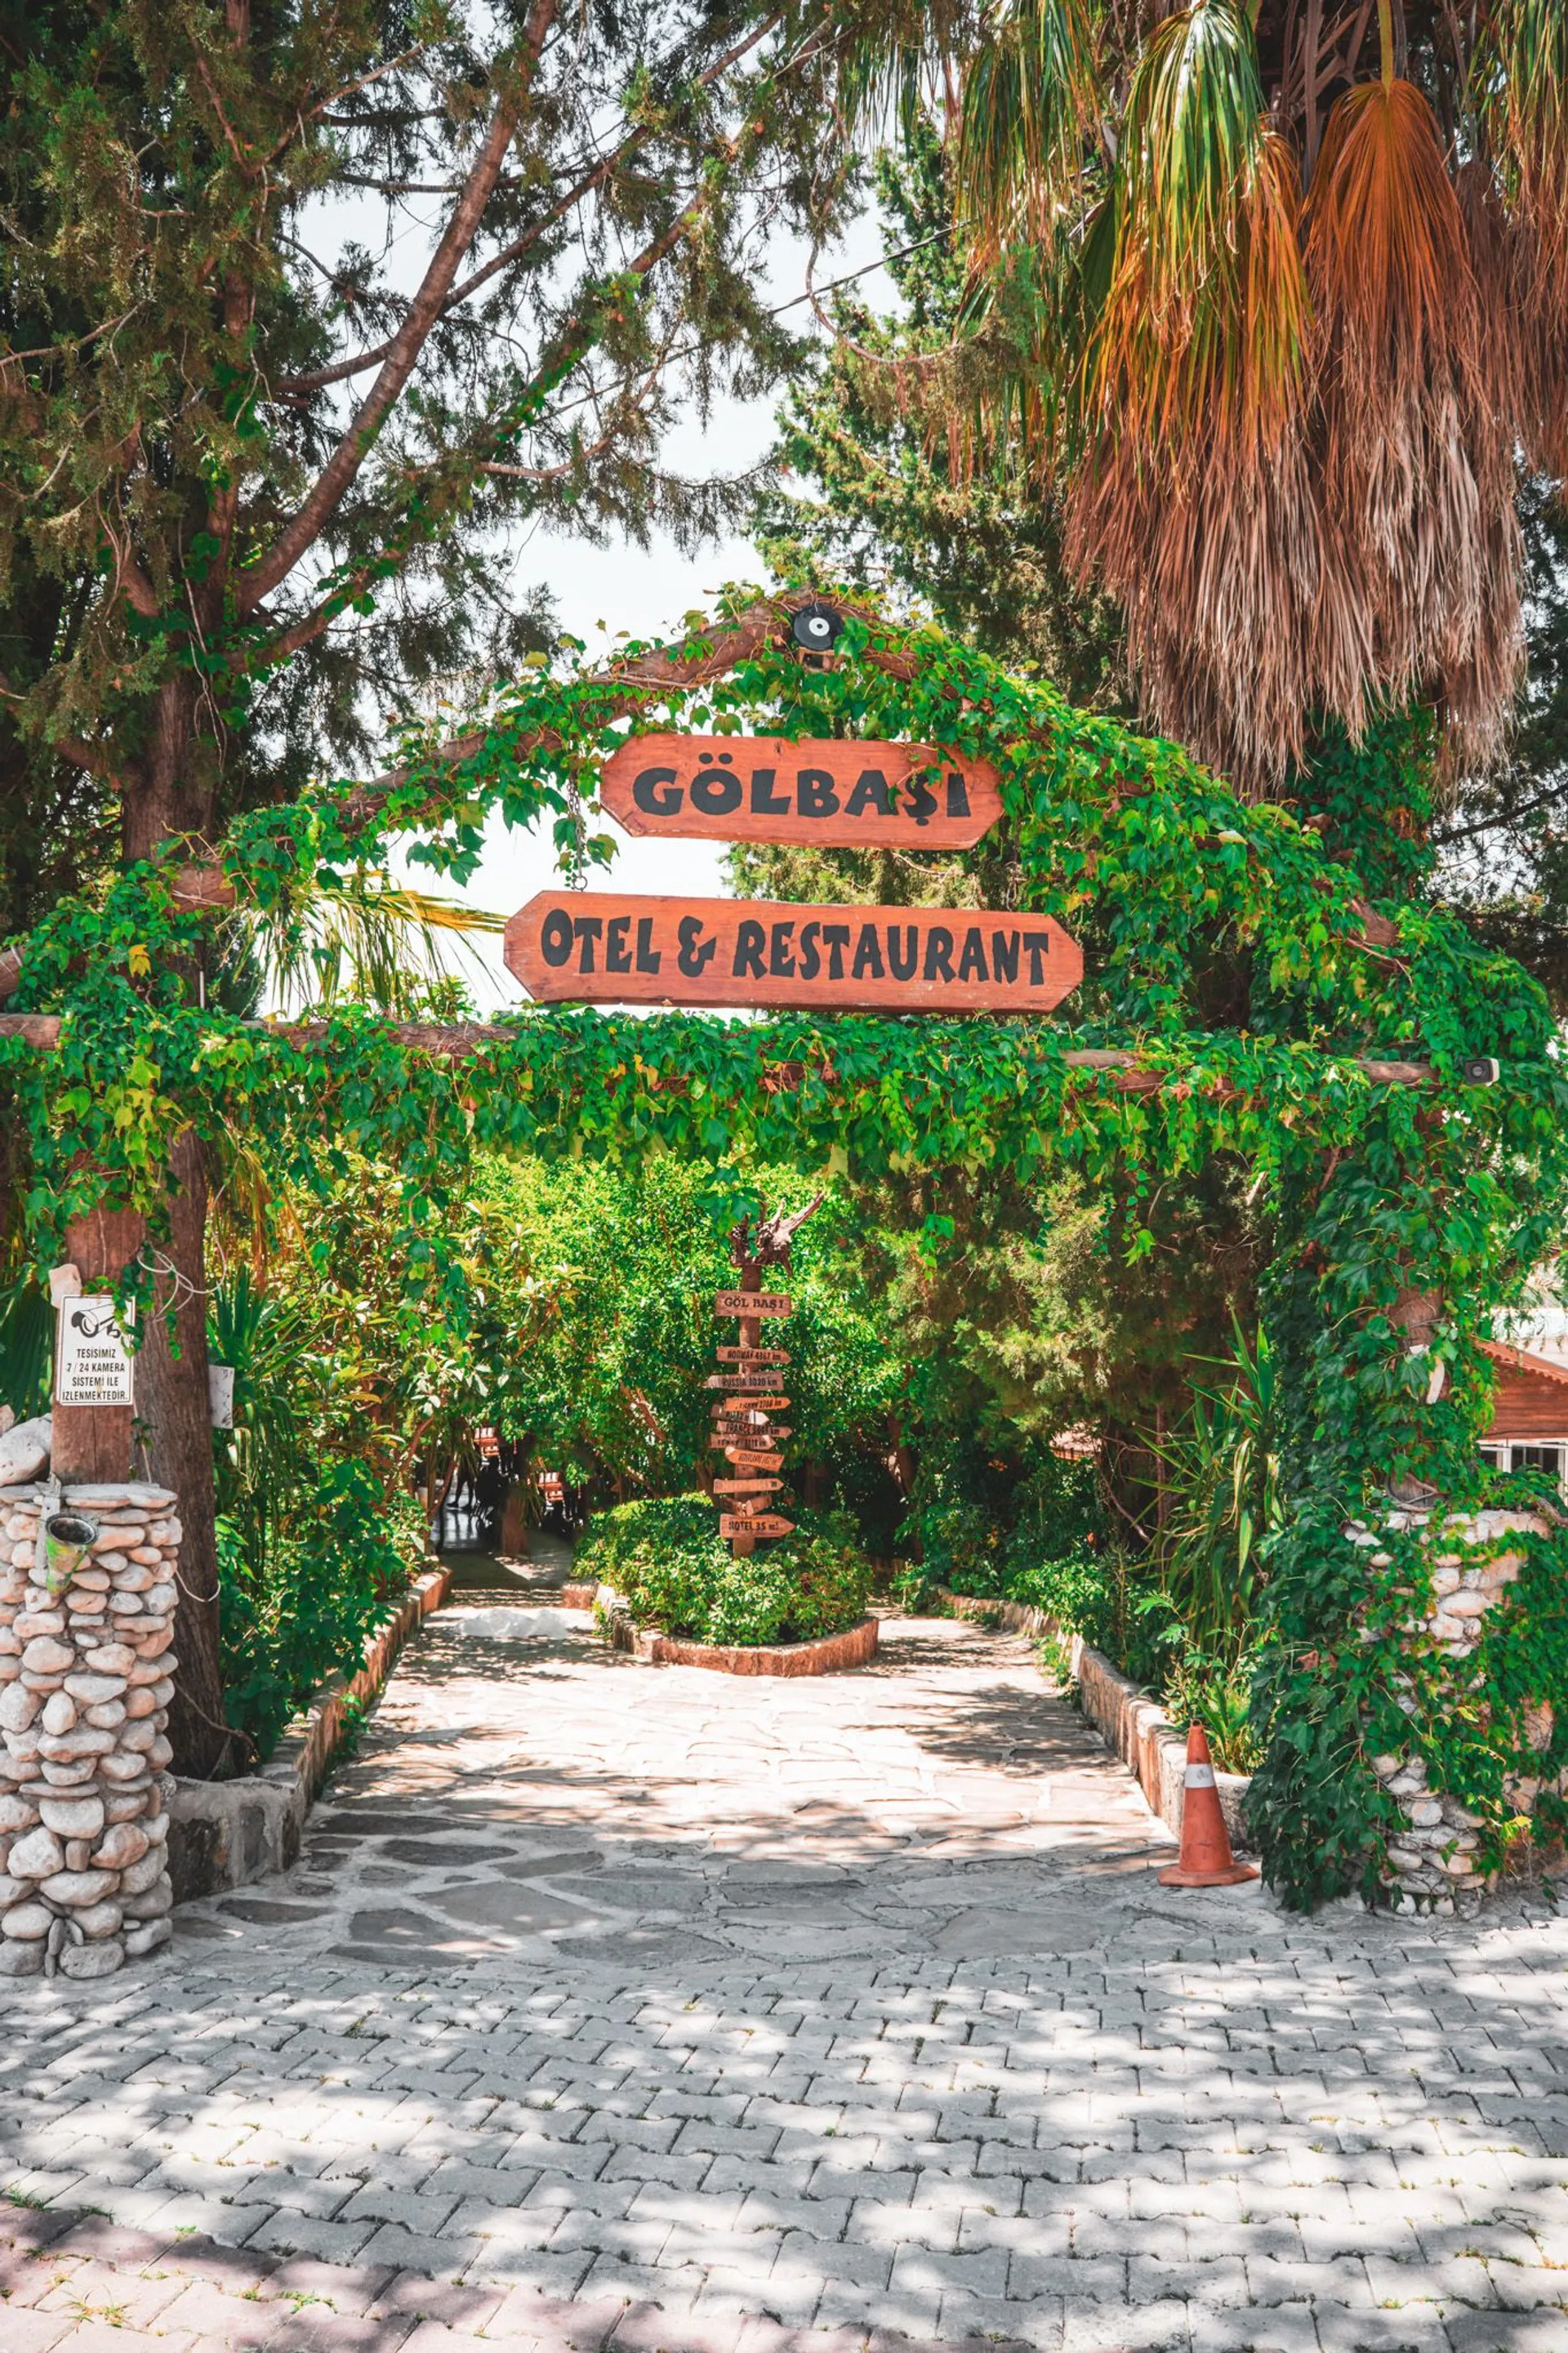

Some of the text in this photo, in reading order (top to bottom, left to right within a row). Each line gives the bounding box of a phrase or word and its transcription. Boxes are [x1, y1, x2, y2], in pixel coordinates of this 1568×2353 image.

[633, 752, 971, 827] GÖLBAŞI
[541, 908, 1050, 986] OTEL & RESTAURANT
[724, 1296, 749, 1308] GÖL
[79, 1363, 90, 1373] 24
[91, 1363, 125, 1373] KAMERA
[728, 1521, 753, 1531] HOTEL
